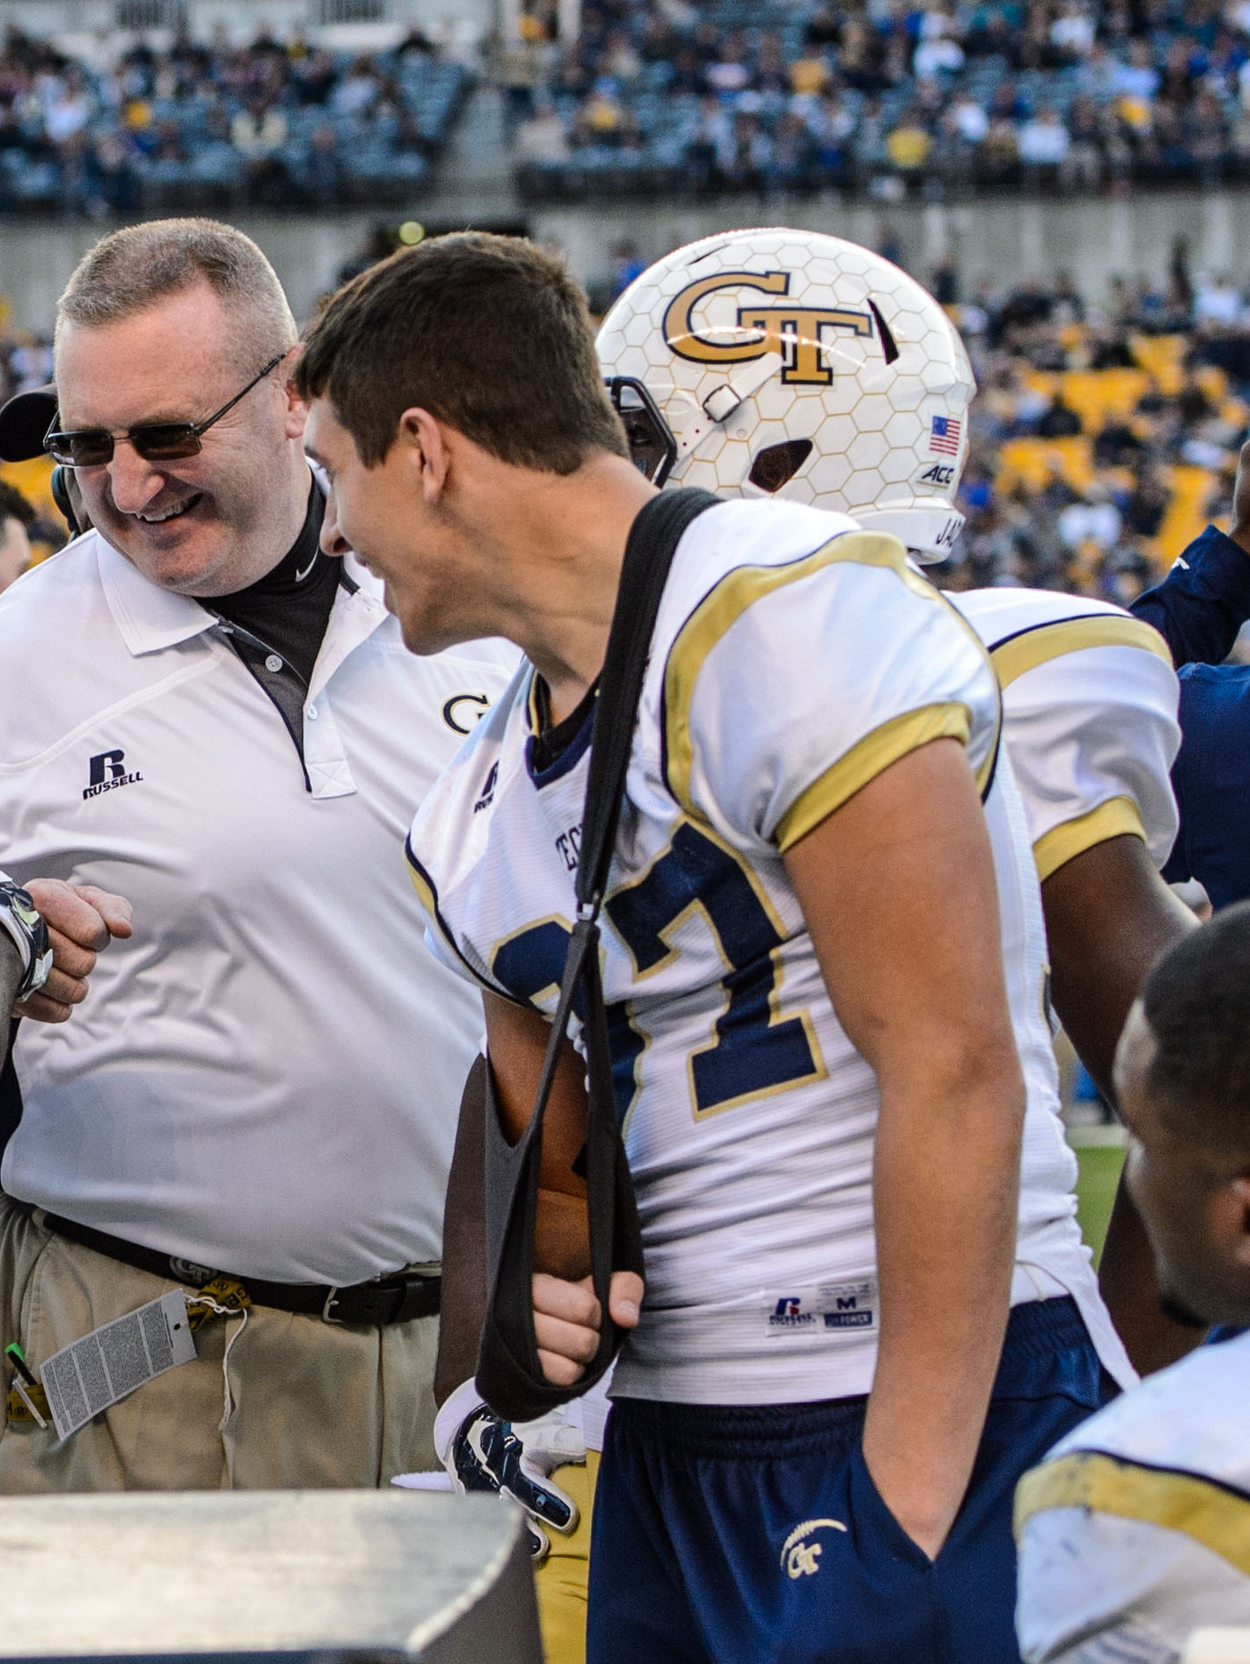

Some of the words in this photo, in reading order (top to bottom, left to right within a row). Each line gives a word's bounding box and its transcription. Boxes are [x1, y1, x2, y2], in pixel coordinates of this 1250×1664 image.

[662, 270, 873, 386] GT
[921, 465, 955, 485] ACC
[82, 771, 144, 801] RUSSELL
[555, 822, 584, 872] TEC
